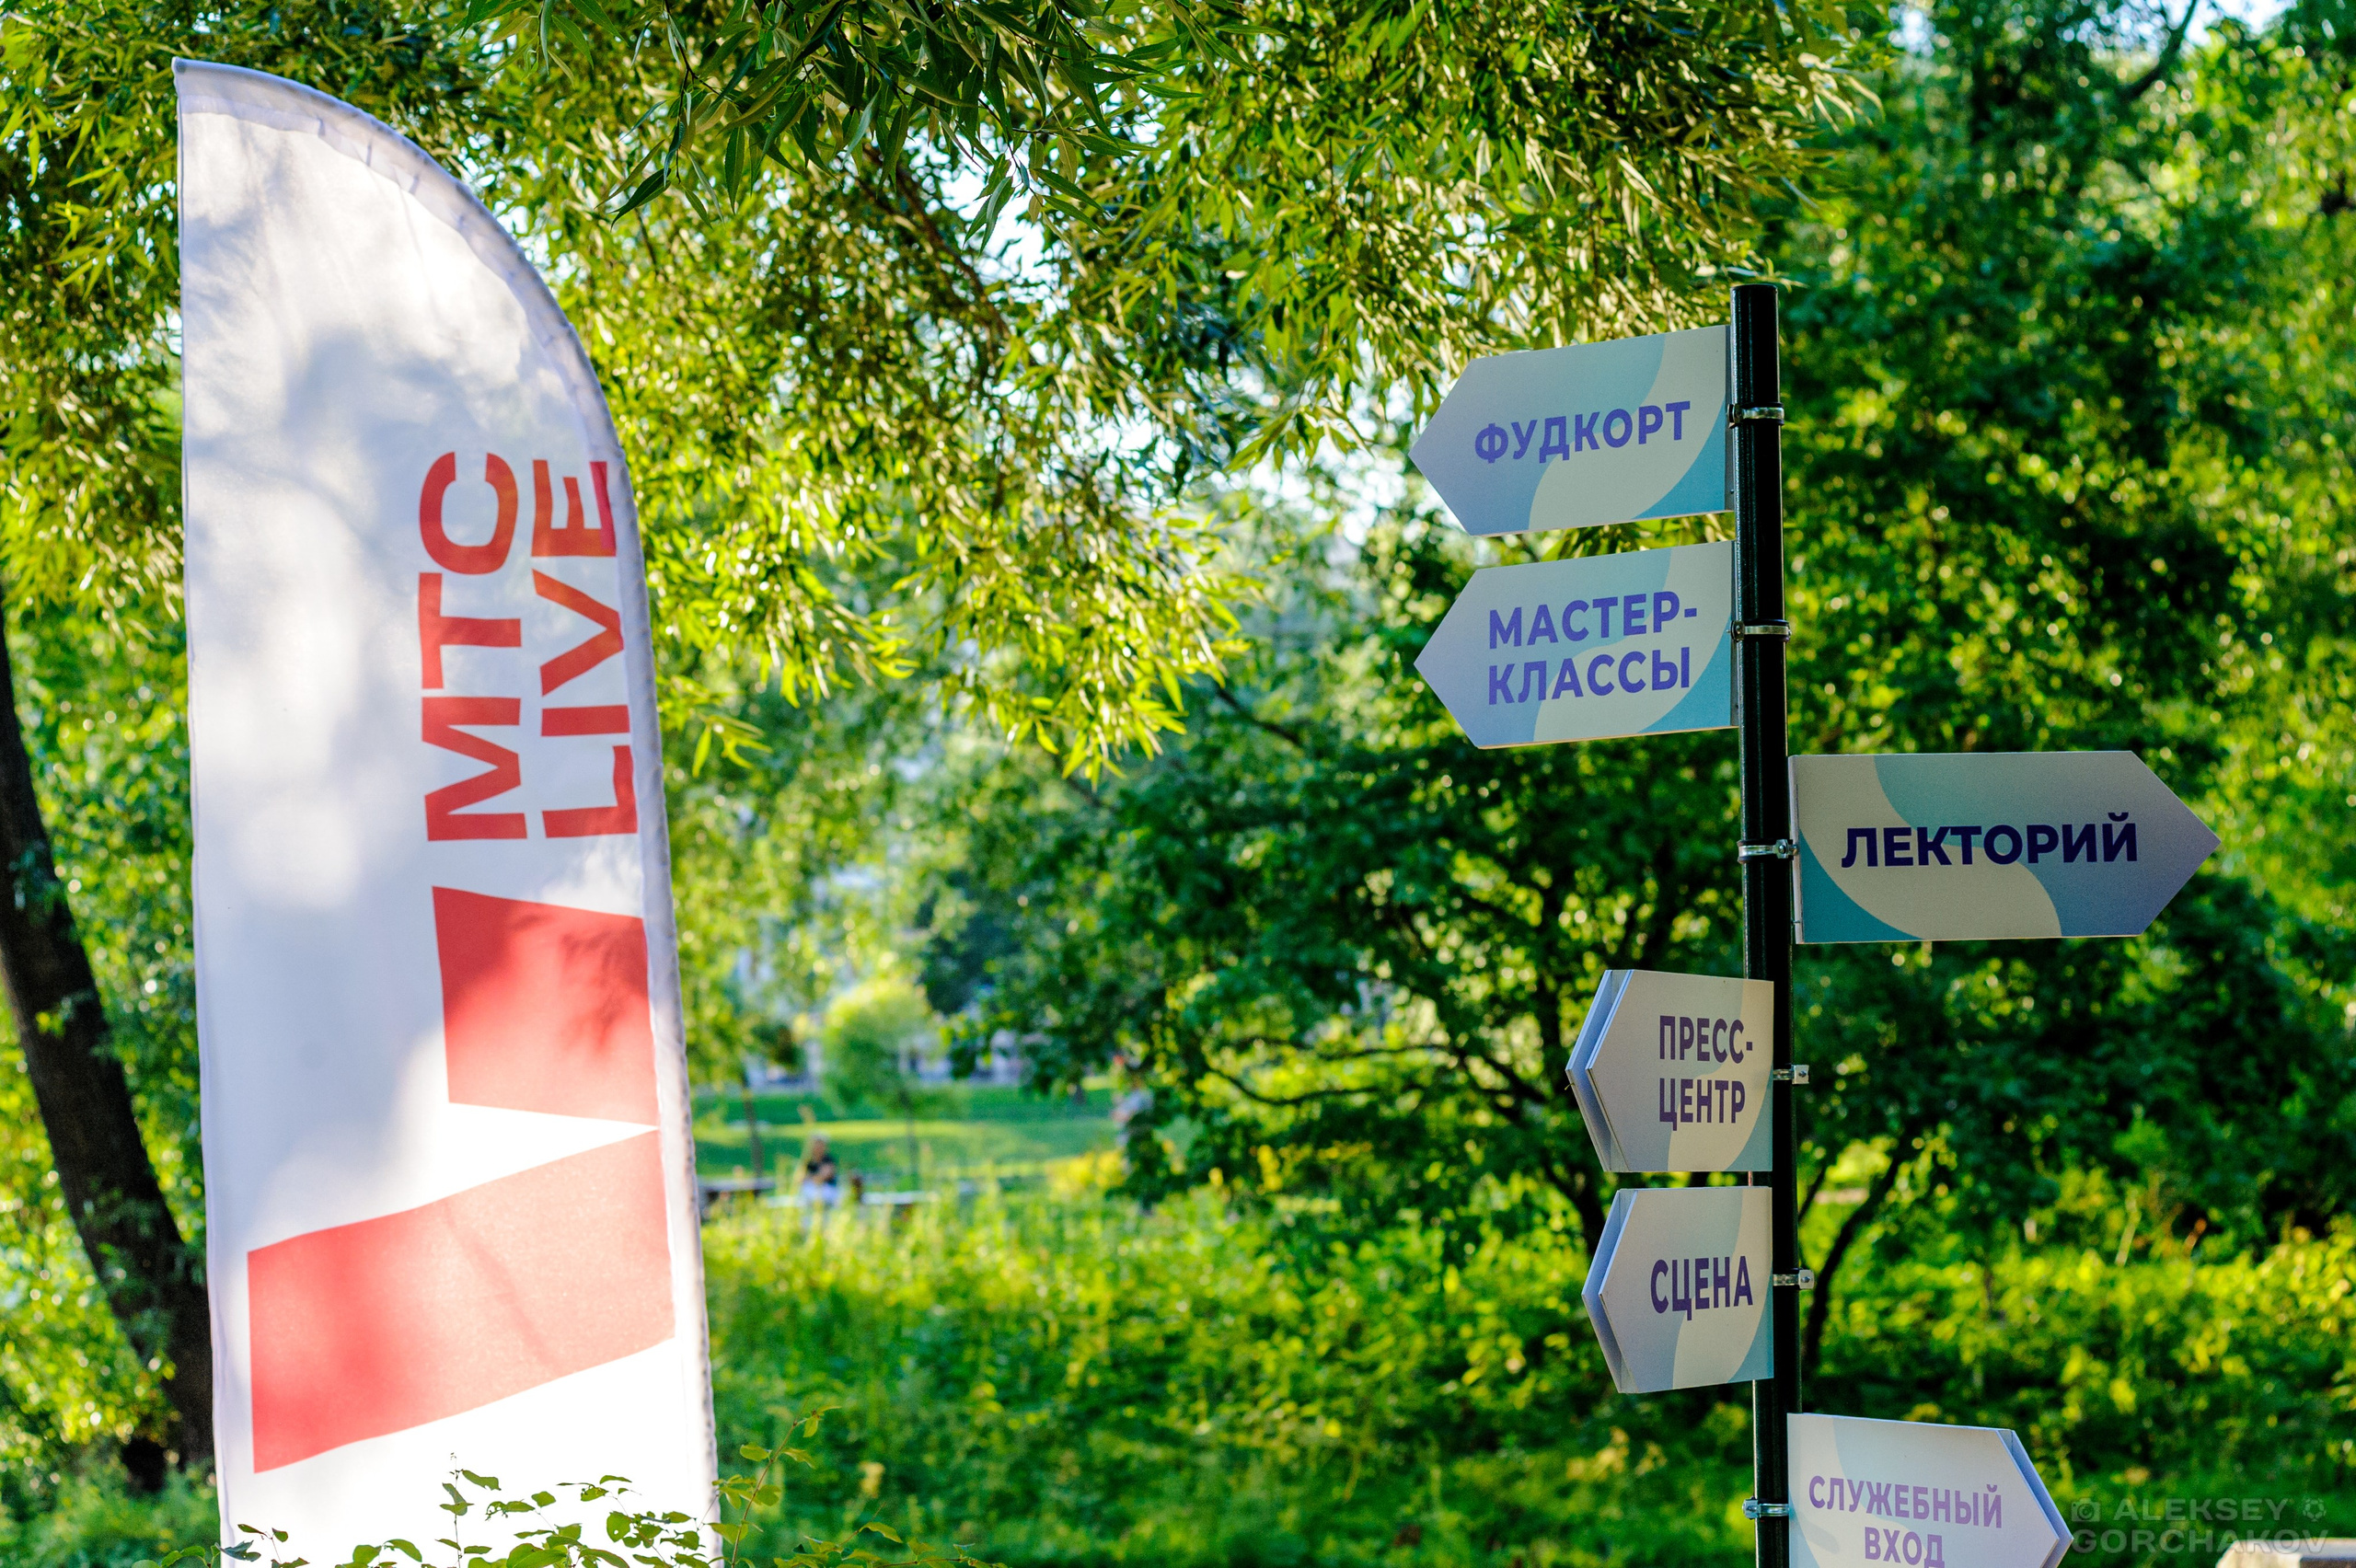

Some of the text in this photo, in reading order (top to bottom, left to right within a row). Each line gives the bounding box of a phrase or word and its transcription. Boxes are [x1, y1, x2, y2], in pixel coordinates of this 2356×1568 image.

[1474, 400, 1691, 464] ФУДКОРТ
[531, 459, 639, 839] LIVE
[1489, 591, 1697, 650] МАСТЕР-
[1488, 647, 1690, 705] КЛАССЫ
[1841, 812, 2139, 868] ЛЕКТОРИЙ
[1658, 1015, 1753, 1064] ПРЕСС-
[1658, 1078, 1746, 1131] ЦЕНТР
[1650, 1255, 1753, 1321] СЦЕНА
[1808, 1475, 2003, 1529] СЛУЖЕБНЫЙ
[1864, 1526, 1946, 1568] ВХОД
